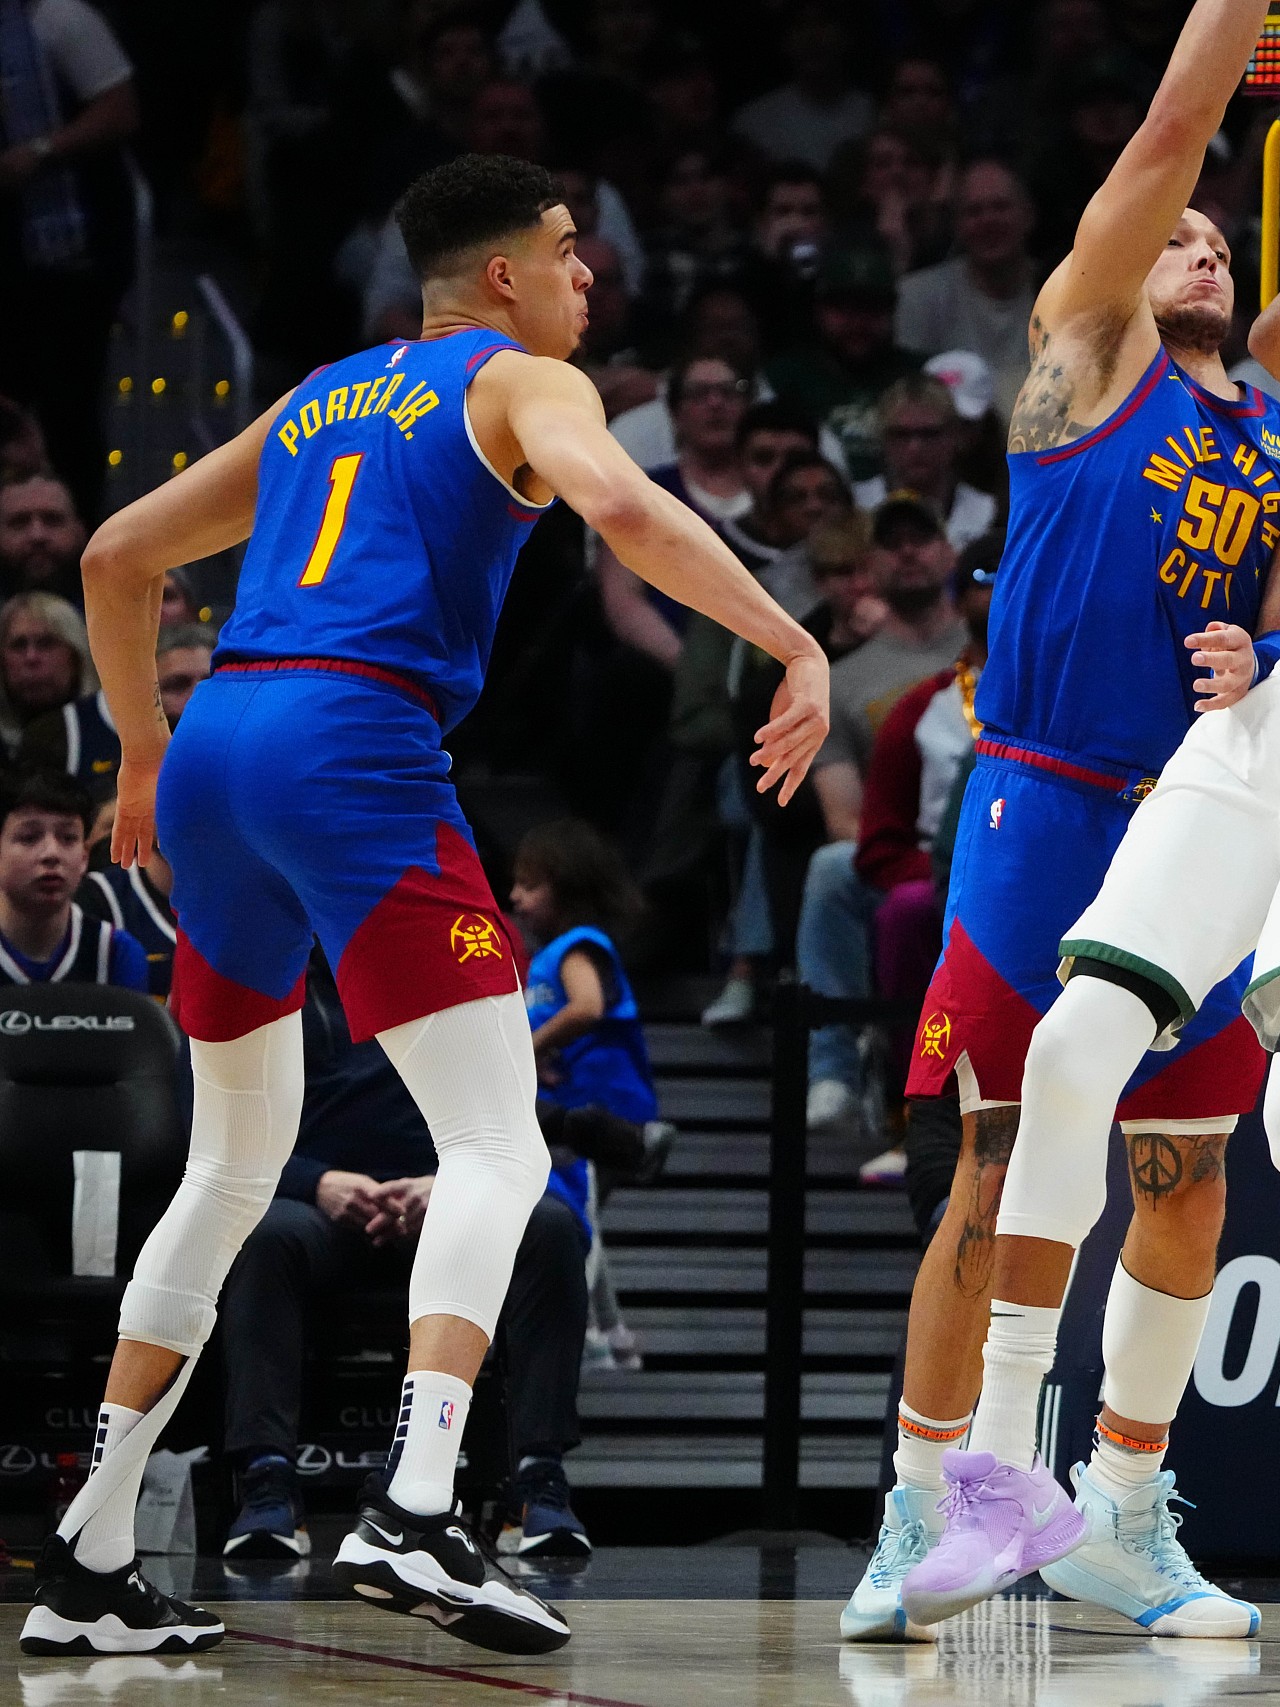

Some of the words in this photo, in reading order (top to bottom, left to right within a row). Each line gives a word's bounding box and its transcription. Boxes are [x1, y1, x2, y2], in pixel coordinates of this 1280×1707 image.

[277, 373, 406, 457] PORTER
[388, 380, 440, 441] JR.
[1142, 427, 1222, 492] MILE
[297, 451, 366, 588] 1
[1176, 474, 1261, 566] 50
[34, 1015, 135, 1031] LEXUS
[45, 1408, 99, 1428] CLU
[339, 1406, 398, 1429] CLU
